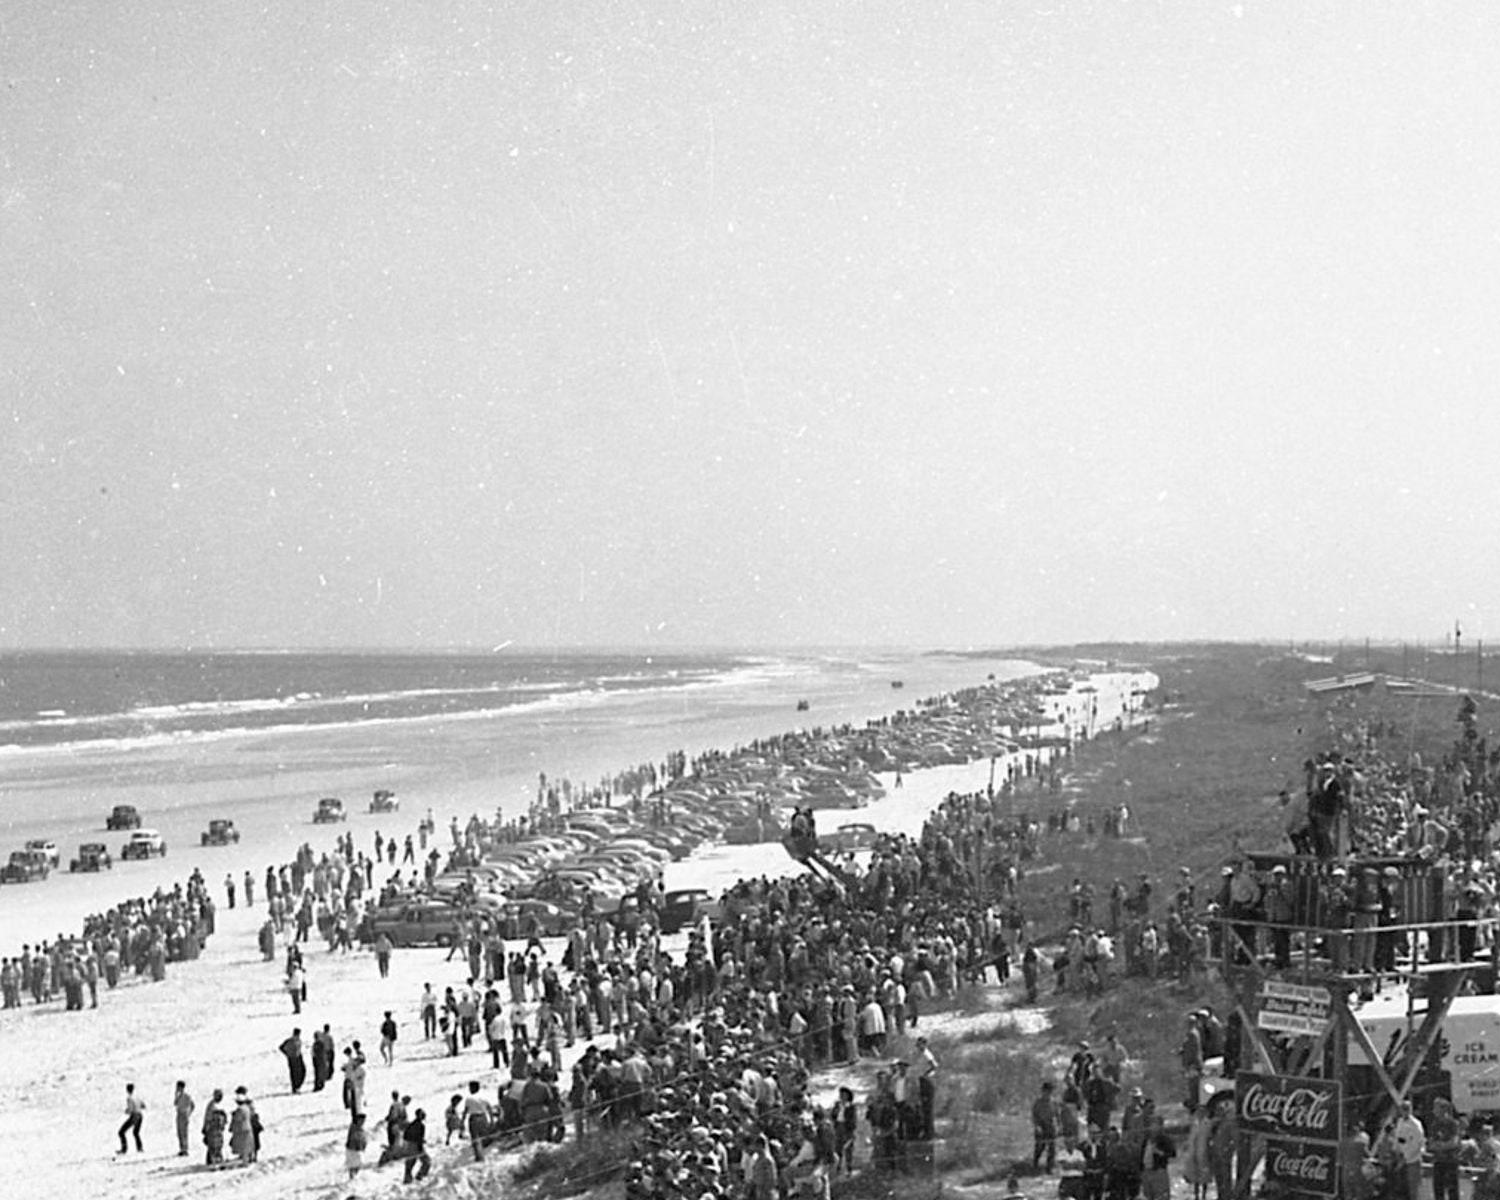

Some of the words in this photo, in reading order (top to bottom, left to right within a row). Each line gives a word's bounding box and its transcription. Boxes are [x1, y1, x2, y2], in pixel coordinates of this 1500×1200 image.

[1465, 1042, 1485, 1052] ICE
[1454, 1053, 1499, 1065] CREAM
[1242, 1083, 1334, 1129] Coca-Cola
[1273, 1151, 1330, 1181] Coca-Cola
